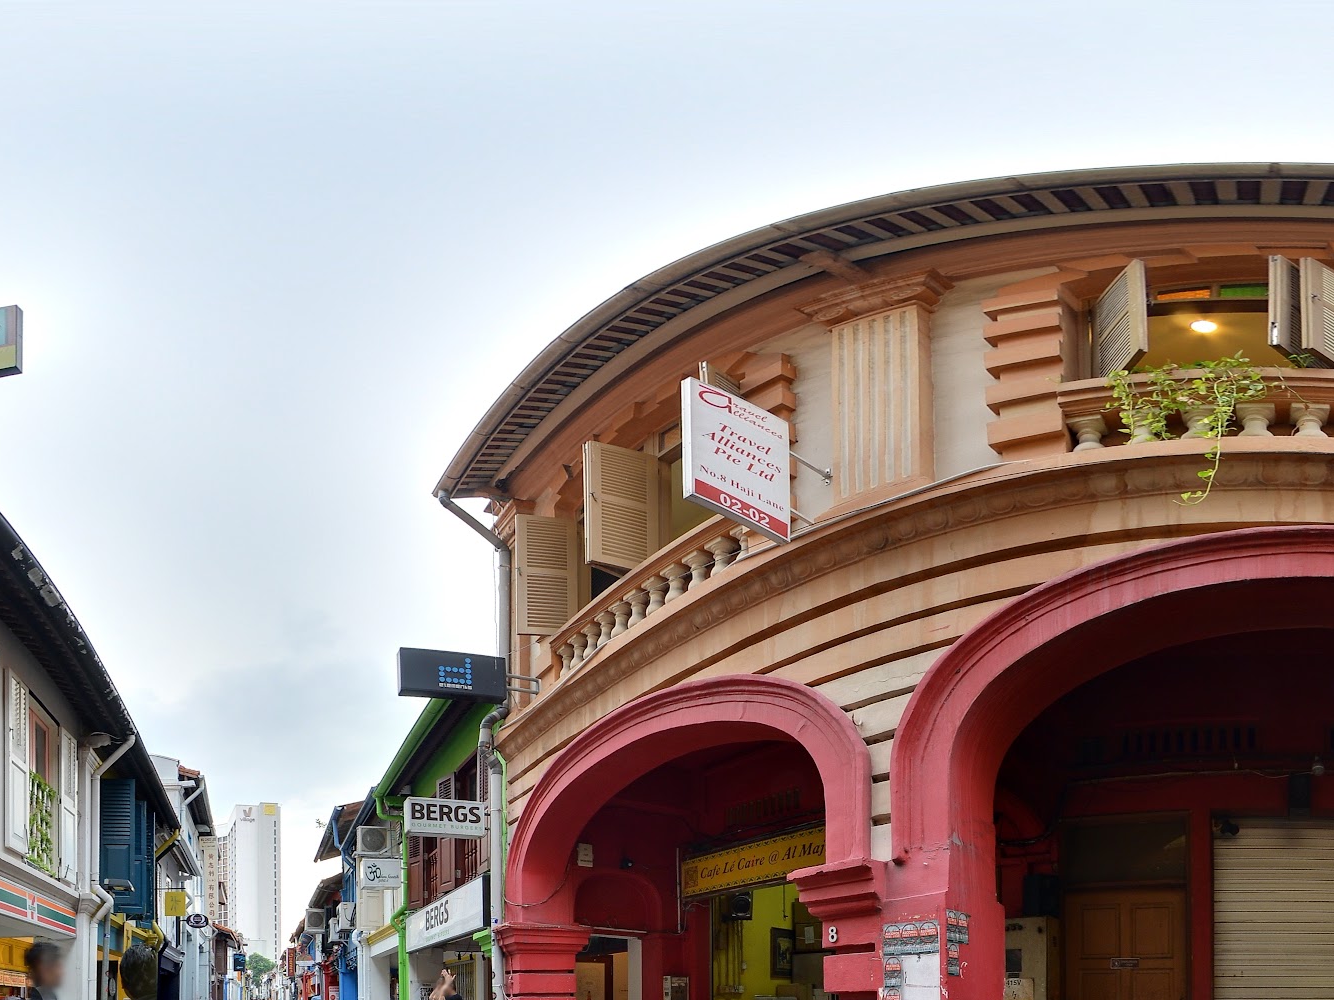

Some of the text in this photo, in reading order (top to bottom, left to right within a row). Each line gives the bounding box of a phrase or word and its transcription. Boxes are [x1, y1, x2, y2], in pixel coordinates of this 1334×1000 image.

[702, 431, 782, 474] Alliances
[719, 422, 771, 456] Travel
[713, 447, 776, 482] Pte Ltd
[699, 464, 784, 512] No.8 Haji Lane
[719, 493, 770, 528] 02-02
[411, 803, 481, 823] BERGS
[700, 866, 721, 879] Cafe
[723, 861, 735, 874] Lé
[737, 855, 765, 870] Caire
[768, 850, 780, 865] @
[782, 845, 796, 860] Al
[425, 900, 449, 931] BERGS
[828, 926, 837, 943] 8
